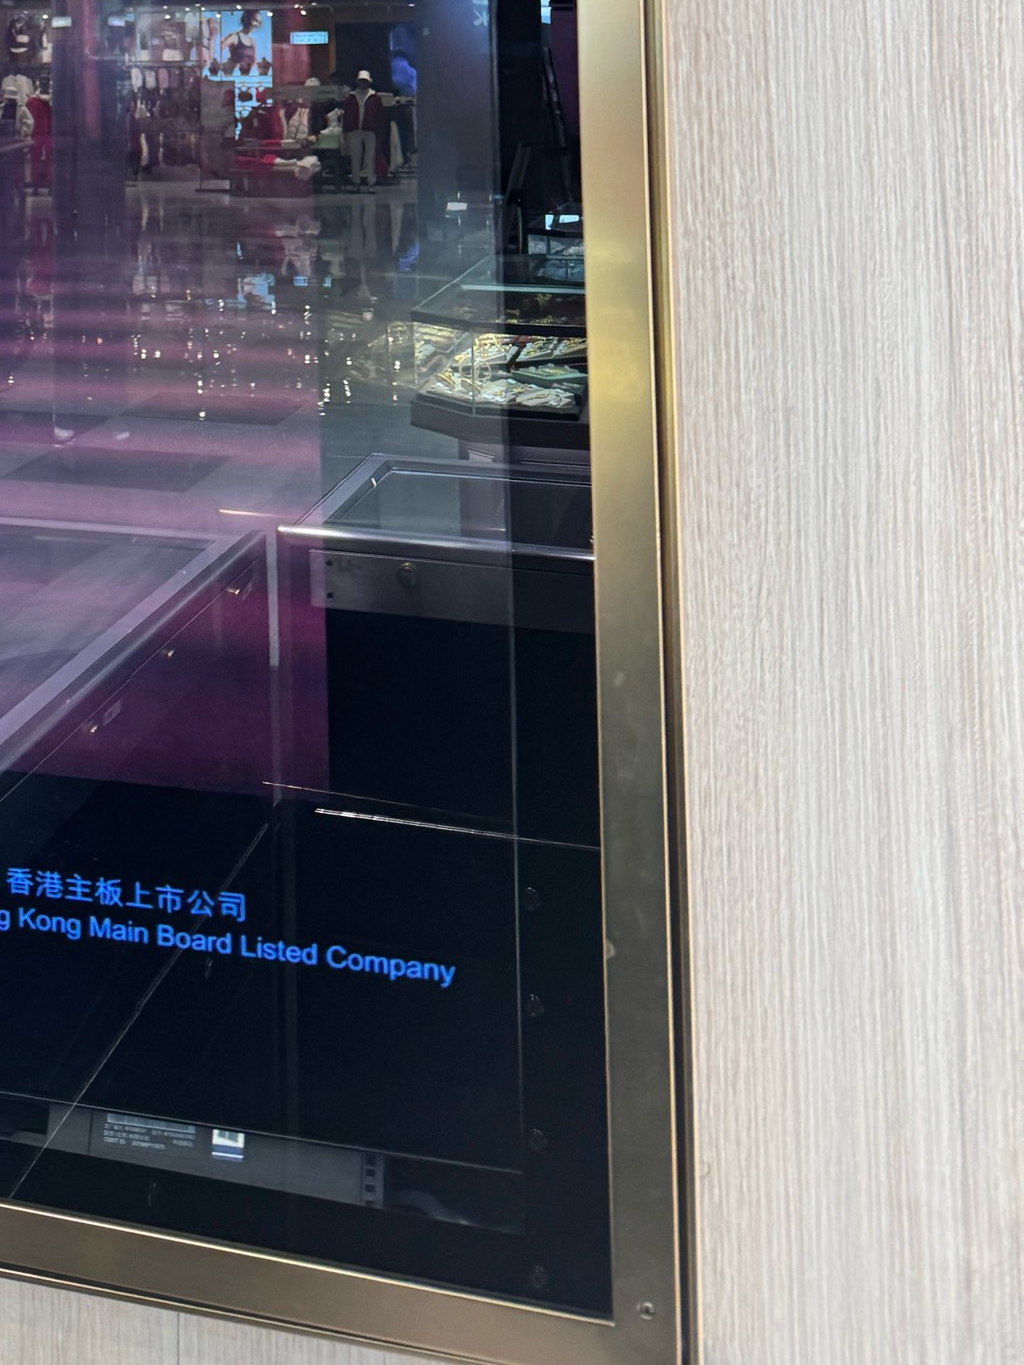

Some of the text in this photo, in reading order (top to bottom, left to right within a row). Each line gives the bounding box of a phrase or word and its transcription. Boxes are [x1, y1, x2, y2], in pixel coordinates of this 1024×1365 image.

[6, 867, 247, 922] 香港主板上市公司
[18, 908, 82, 939] Kong
[89, 916, 148, 945] Main
[157, 925, 231, 954] Board
[241, 935, 318, 966] Listed
[326, 945, 456, 988] Company
